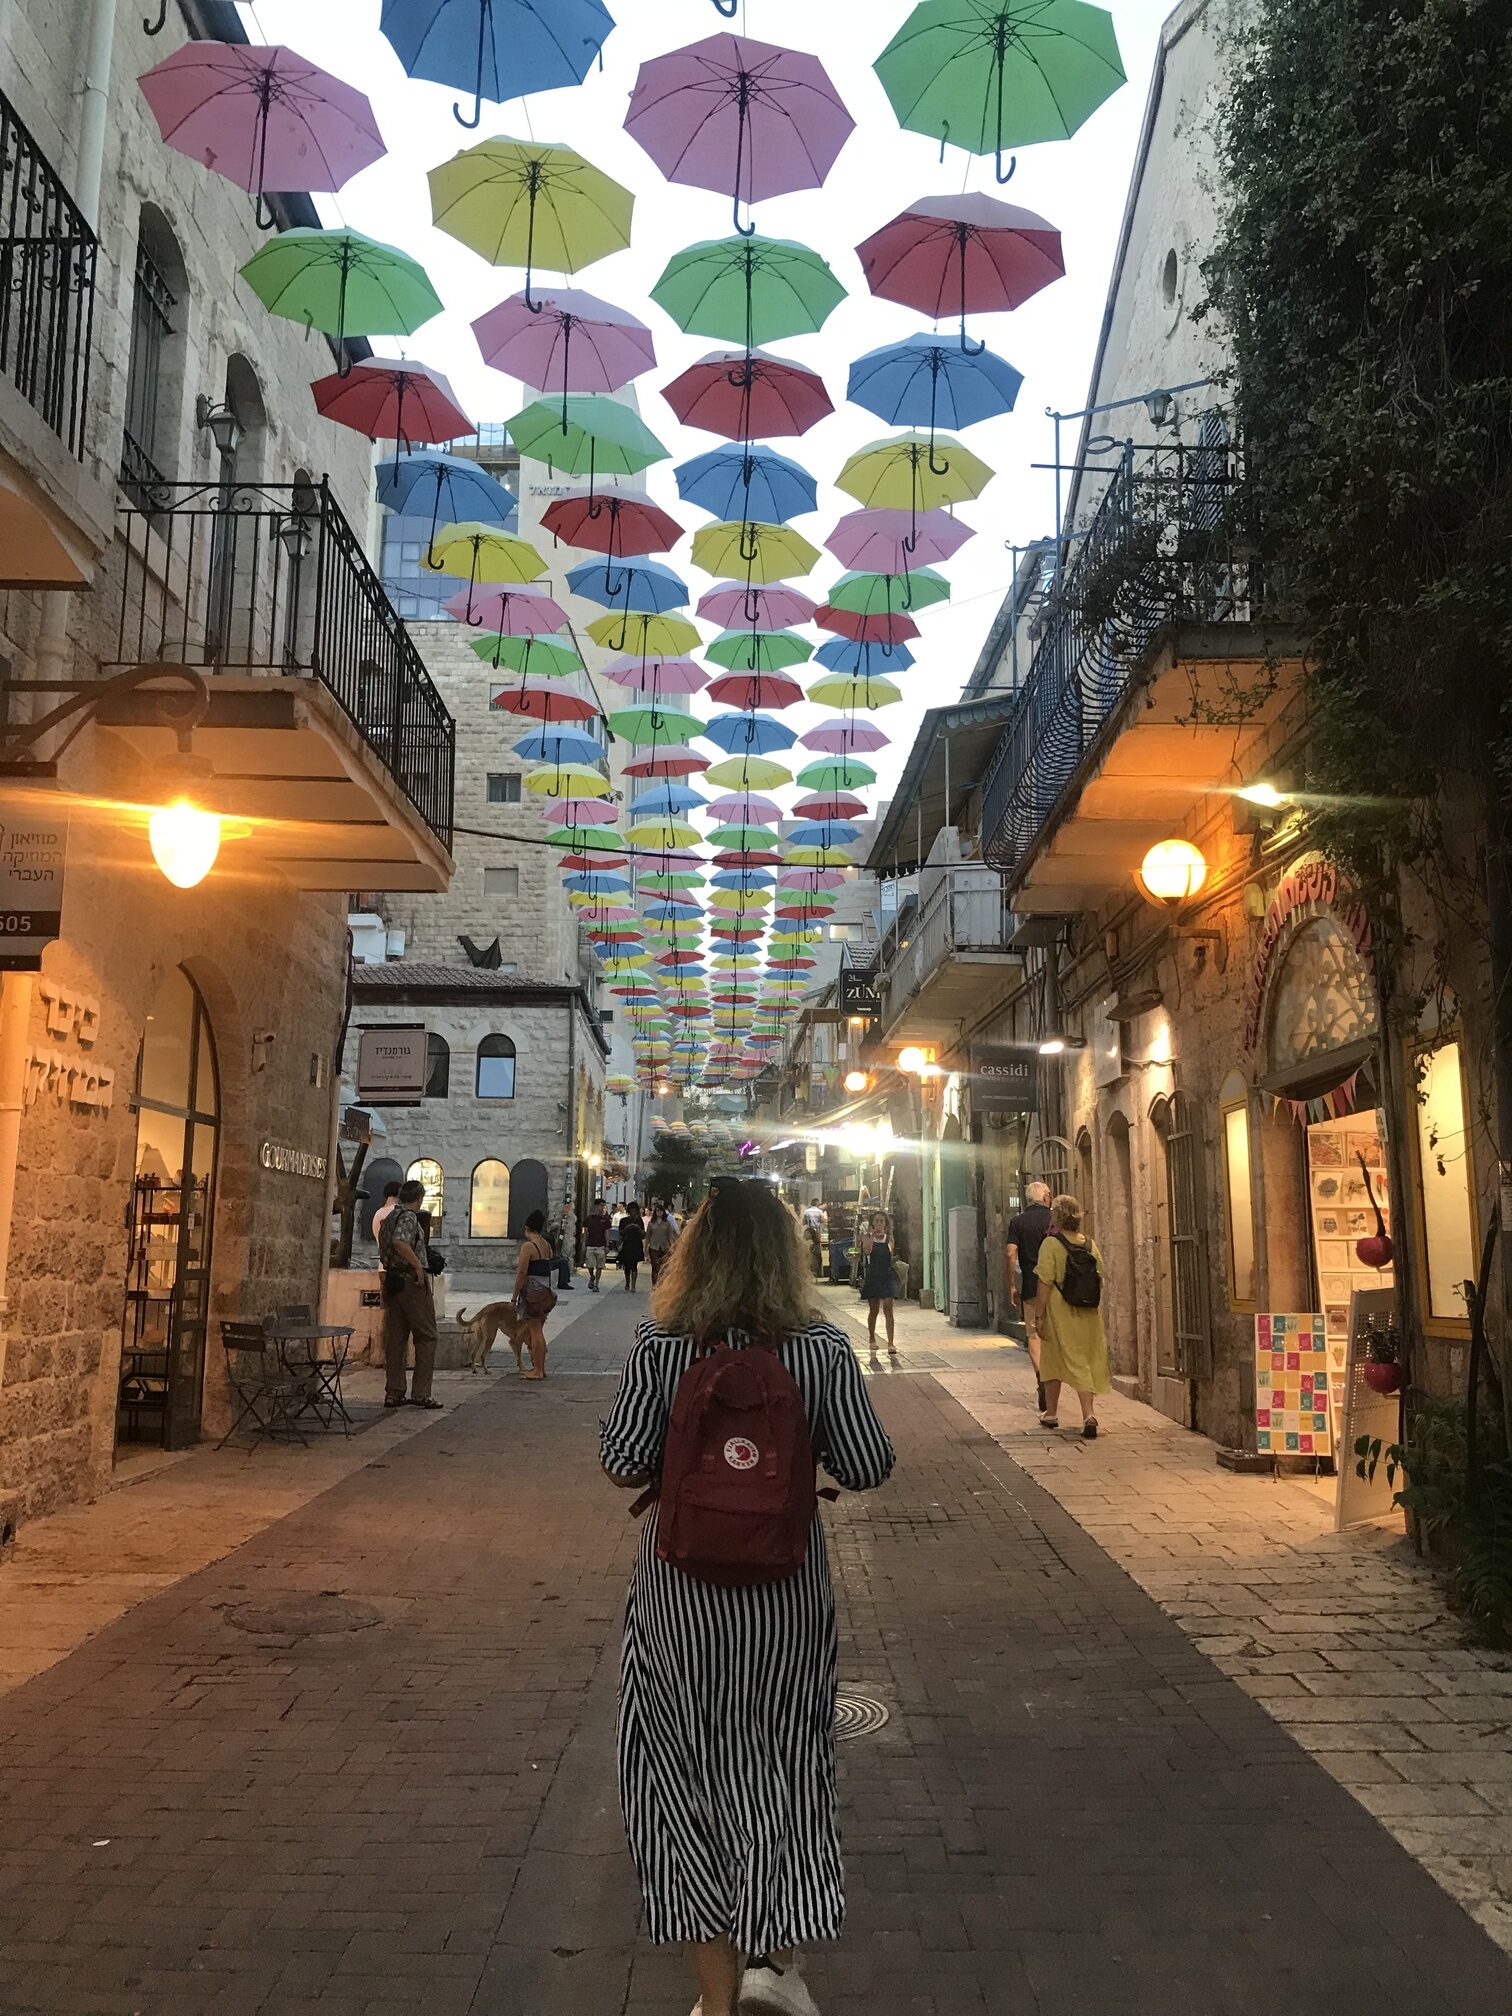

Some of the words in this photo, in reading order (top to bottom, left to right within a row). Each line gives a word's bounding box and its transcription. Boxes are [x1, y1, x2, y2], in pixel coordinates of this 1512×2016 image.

[11, 832, 58, 850] מוזיאון
[3, 851, 63, 868] המוזיקה
[9, 868, 54, 882] העברי
[980, 1063, 1028, 1077] cassidi
[262, 1142, 327, 1180] GOURMANDISES
